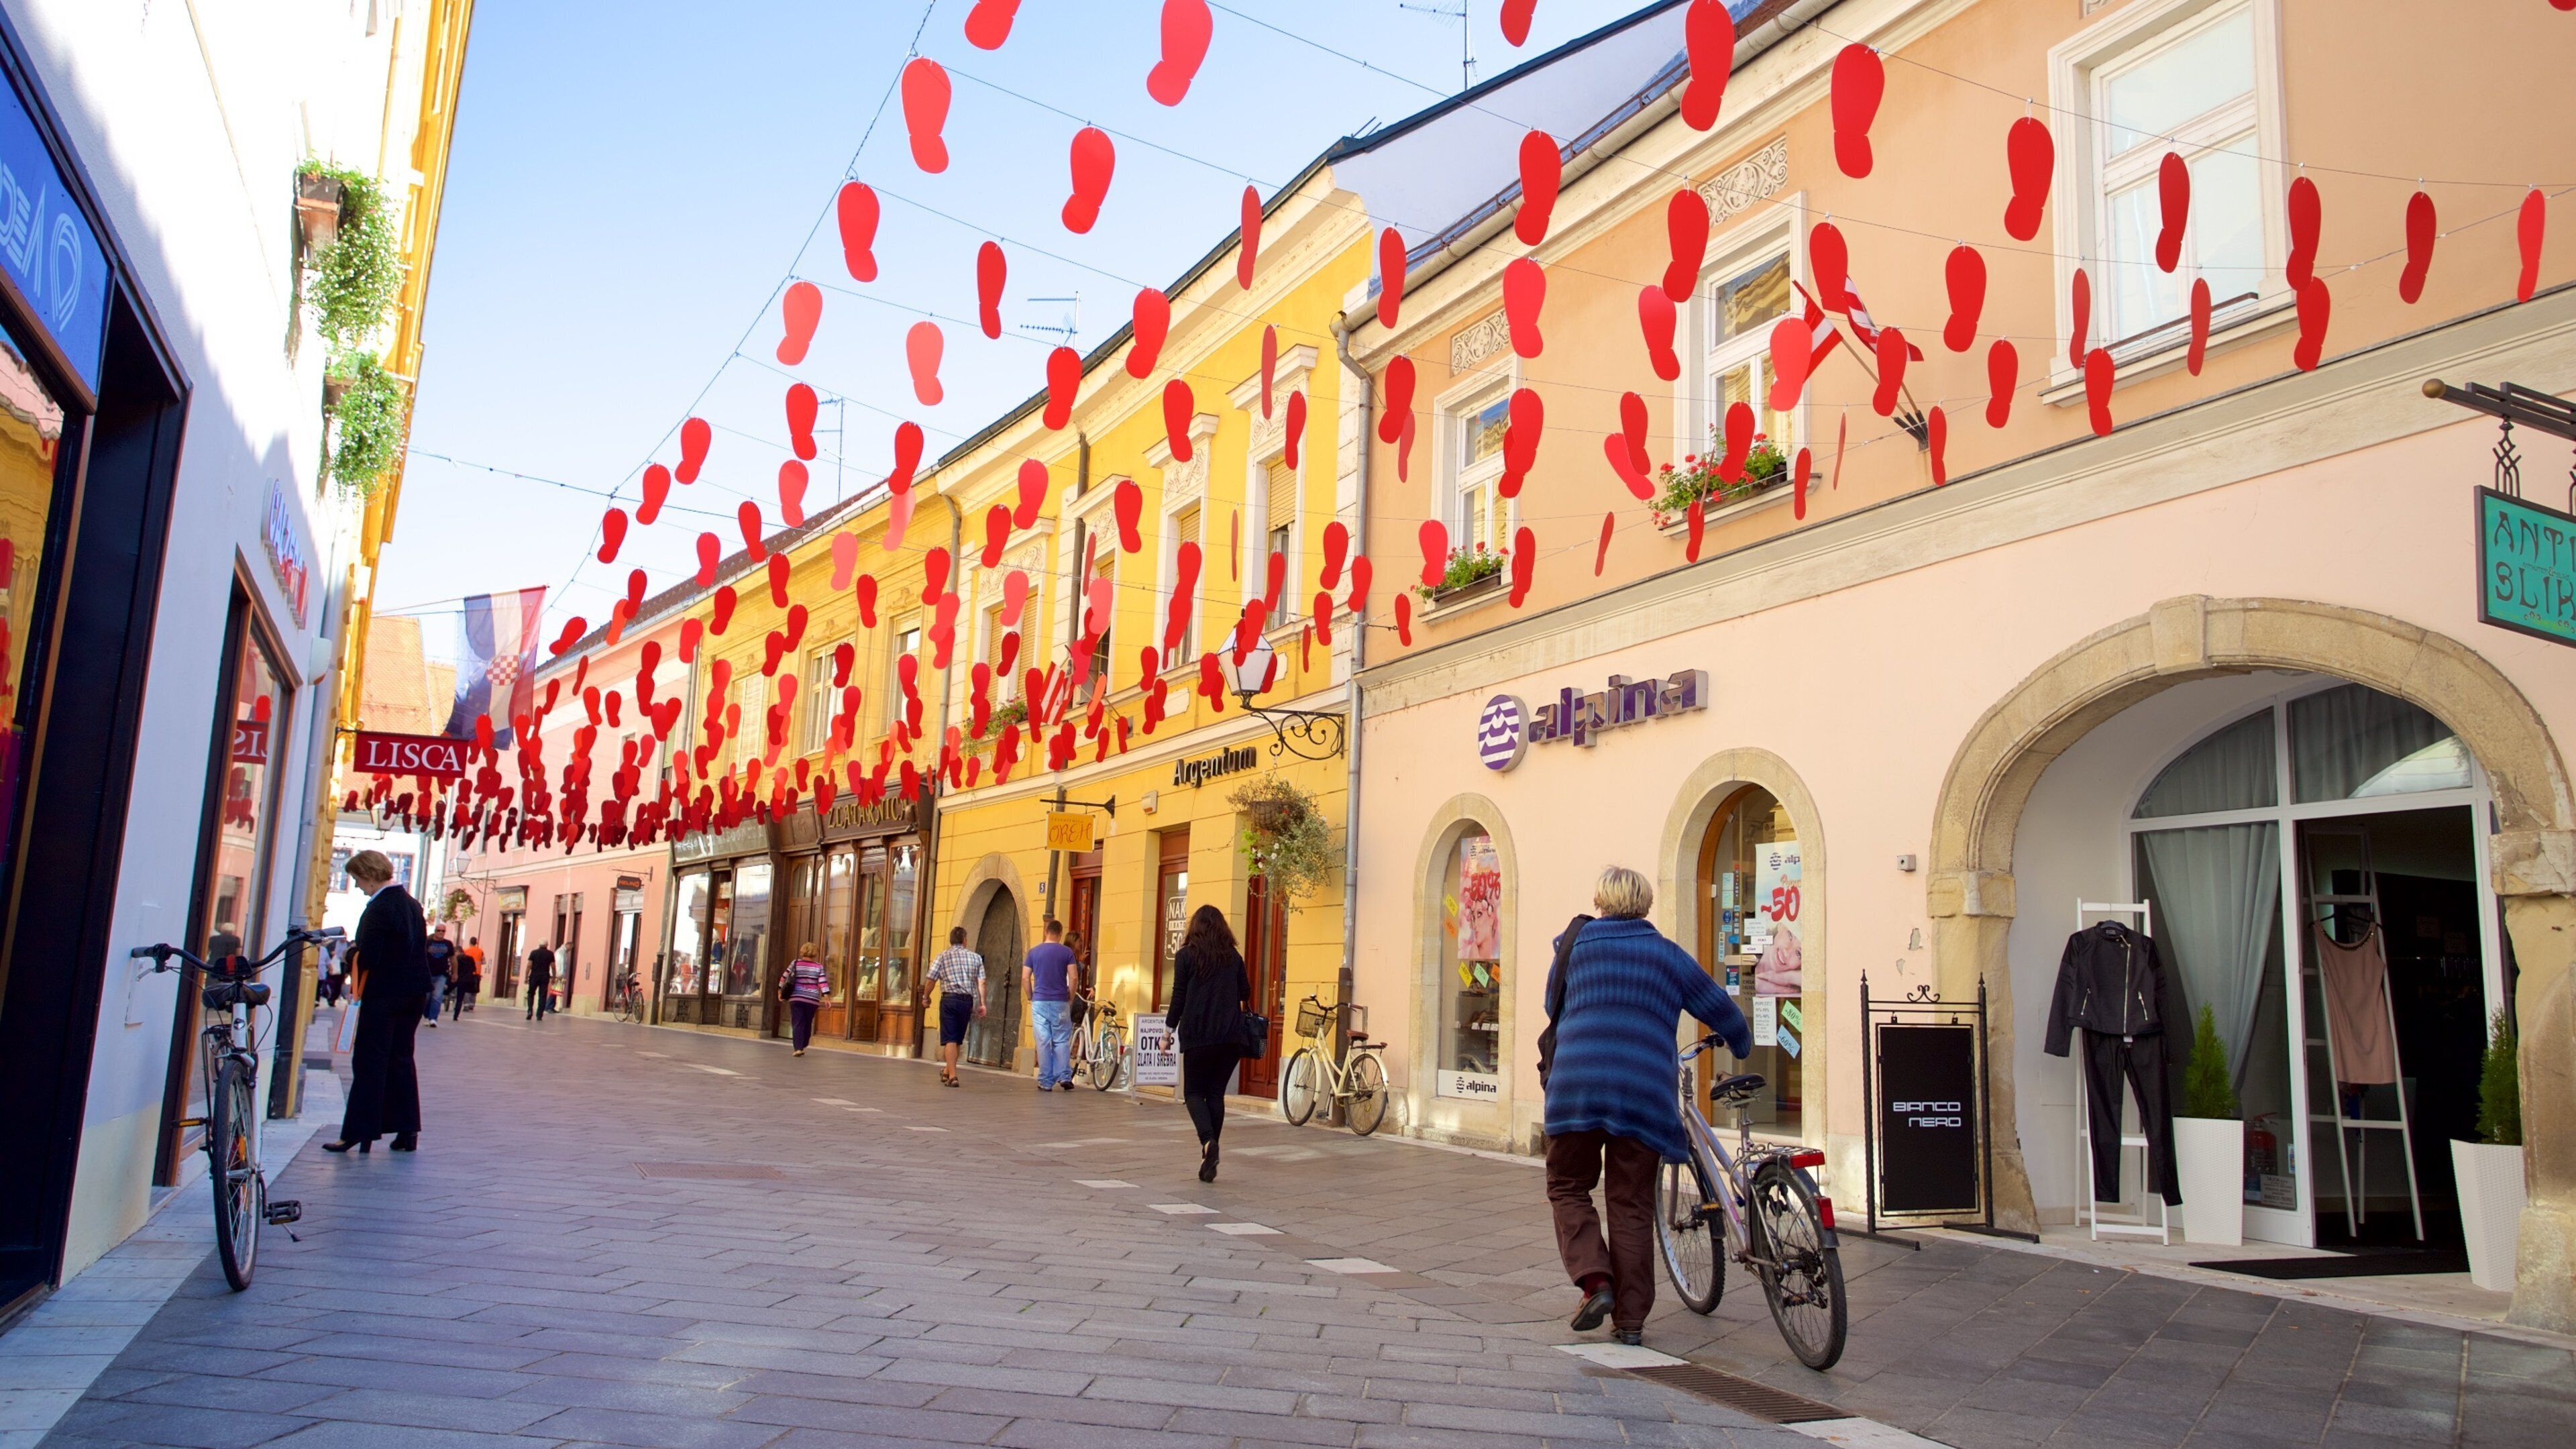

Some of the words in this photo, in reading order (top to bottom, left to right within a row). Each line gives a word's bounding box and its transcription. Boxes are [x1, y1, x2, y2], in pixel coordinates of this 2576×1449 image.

[1528, 669, 1708, 747] alpina
[366, 741, 462, 771] LISCA
[1173, 746, 1256, 788] Argentum
[828, 796, 907, 829] ZLATARNICA
[1785, 1009, 1800, 1025] -80%
[1141, 1036, 1175, 1051] OTKP
[1779, 1036, 1794, 1053] -60%
[1138, 1053, 1152, 1067] ZLATA
[1466, 1081, 1497, 1093] alpina
[1893, 1102, 1961, 1112] BIANCO
[1909, 1117, 1962, 1127] NERO
